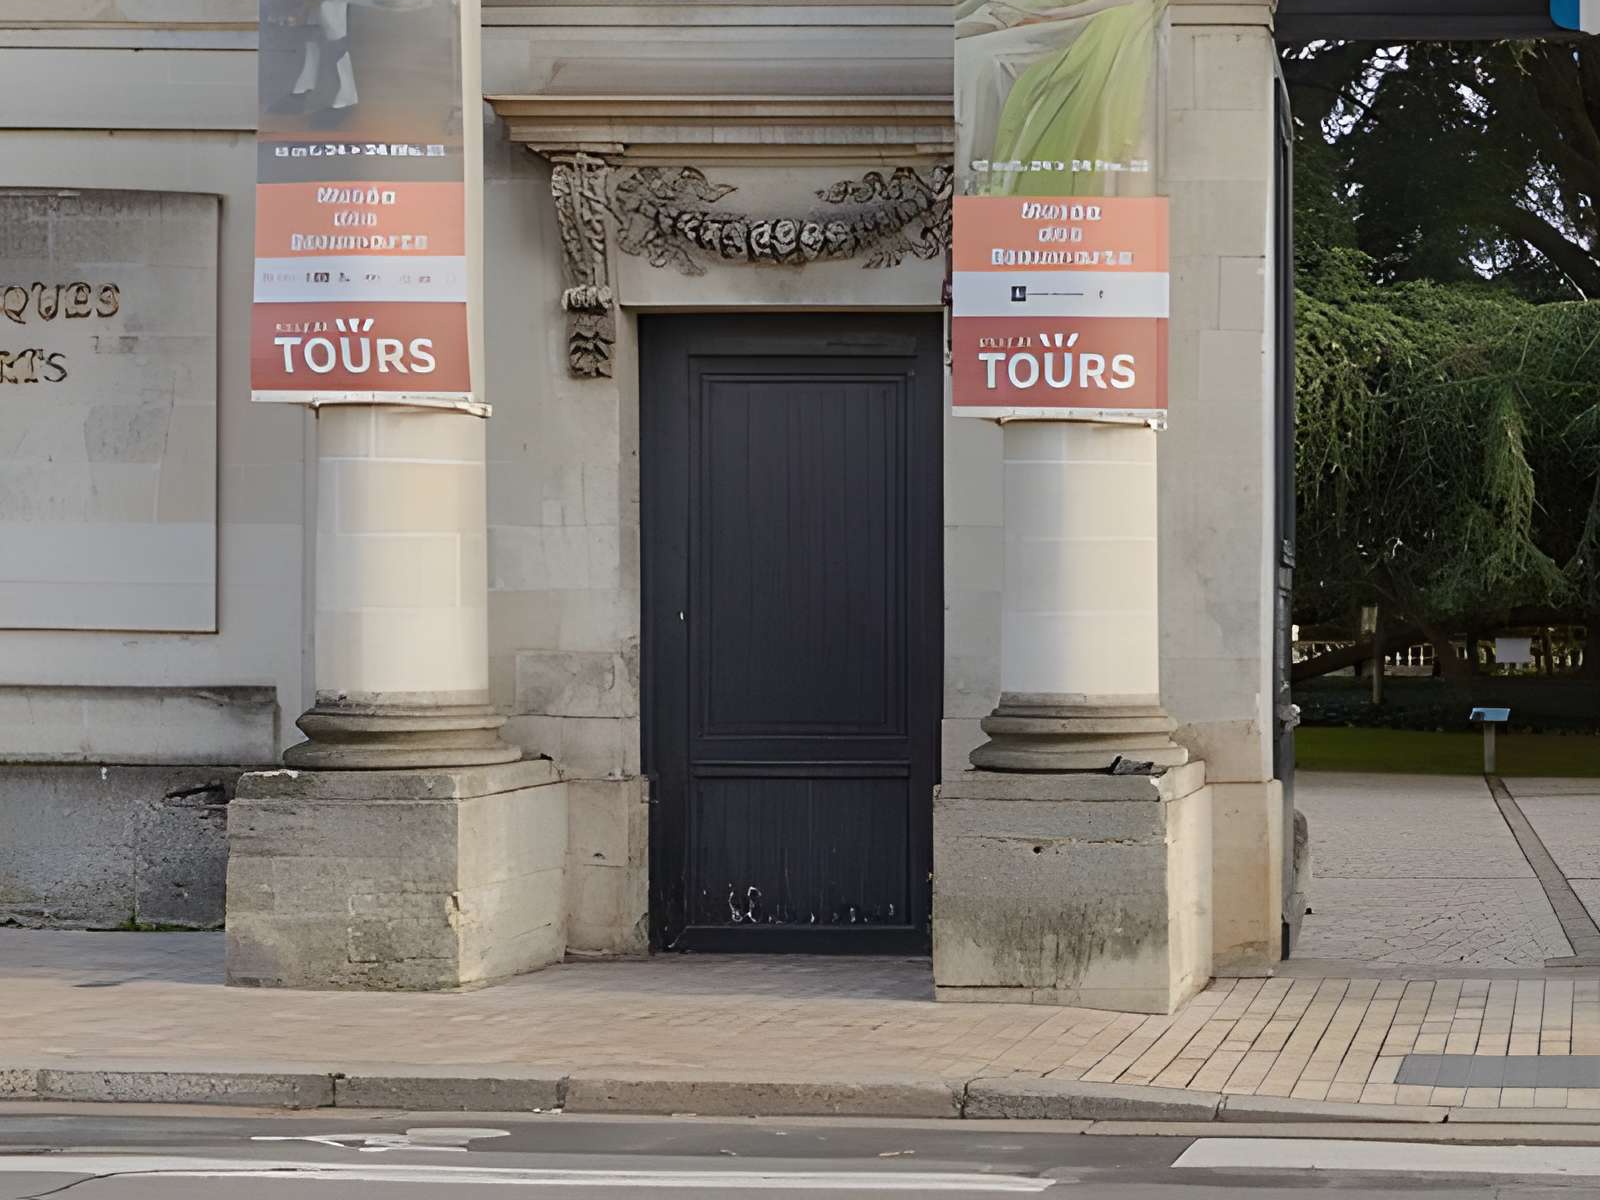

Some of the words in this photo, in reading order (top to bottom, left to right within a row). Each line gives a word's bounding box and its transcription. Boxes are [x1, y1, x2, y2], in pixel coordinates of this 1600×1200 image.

[3, 282, 120, 325] QUES
[274, 336, 436, 374] TOURS
[978, 352, 1136, 389] TOURS
